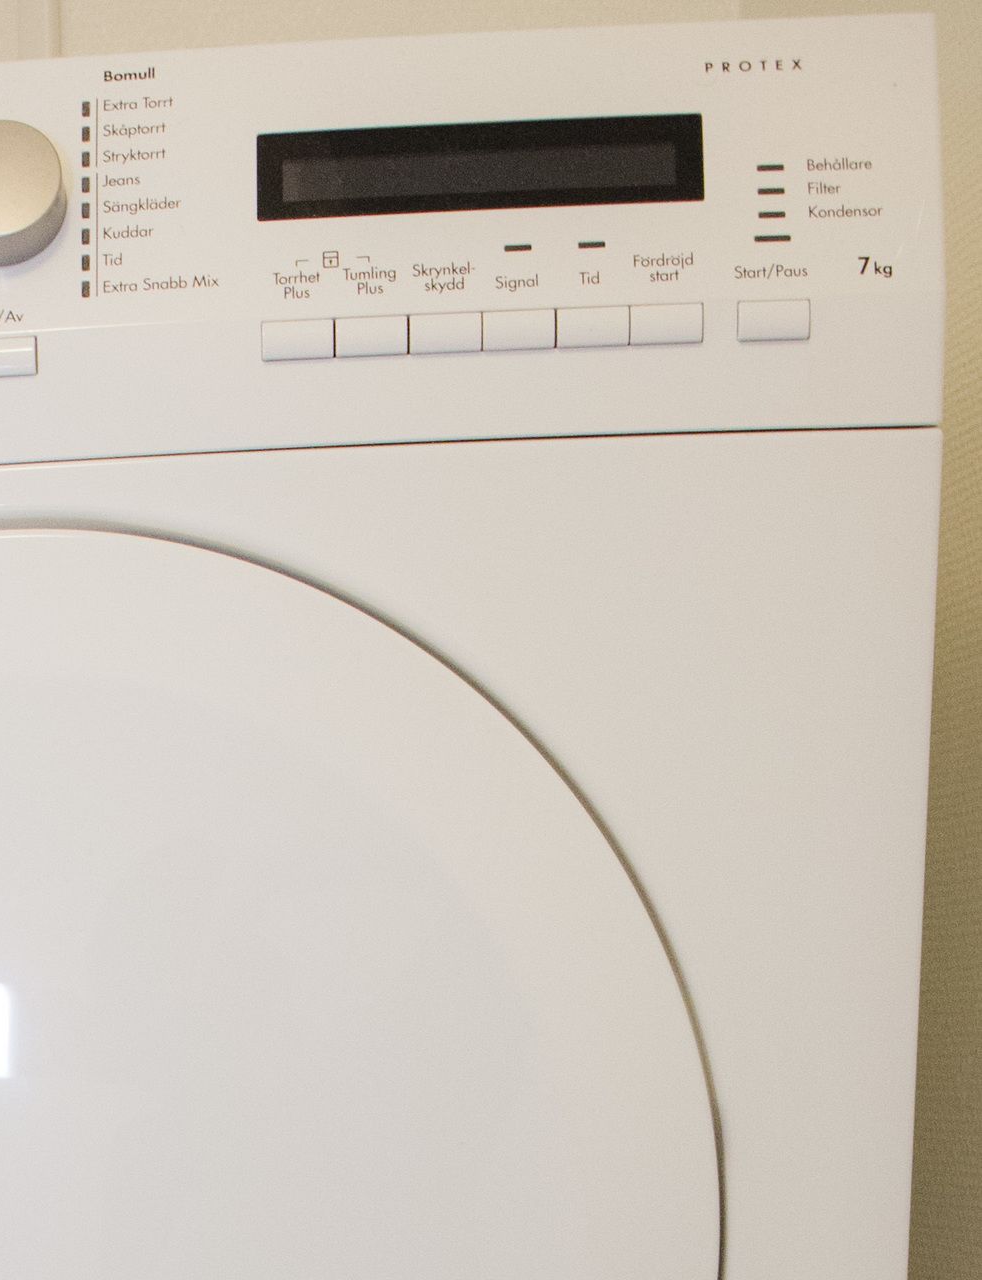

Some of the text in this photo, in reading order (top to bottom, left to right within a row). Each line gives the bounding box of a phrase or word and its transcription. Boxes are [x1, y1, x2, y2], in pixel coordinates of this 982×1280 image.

[704, 59, 803, 73] PROTEX
[104, 68, 155, 81] Bomull
[103, 97, 173, 112] Extra Torrt
[103, 122, 166, 138] Skåptorrt
[103, 148, 166, 164] Stryktorrt
[807, 157, 872, 171] Behållare
[102, 175, 140, 187] Jeans
[807, 182, 841, 195] Filter
[103, 198, 181, 215] Sängkläder
[808, 205, 883, 219] Kondensor
[103, 225, 154, 239] Kuddar
[103, 253, 123, 266] Tid
[633, 252, 694, 270] Fördröjd
[343, 267, 397, 282] Tumling
[649, 267, 680, 283] start
[733, 263, 808, 281] Start/Paus
[858, 257, 892, 279] 7 kg
[103, 275, 219, 293] Extra Snabb Mix
[273, 271, 320, 285] Torrhet
[425, 277, 465, 293] skydd
[495, 273, 539, 292] Signal
[579, 271, 600, 285] Tid
[284, 286, 310, 299] Plus
[357, 282, 384, 295] Plus
